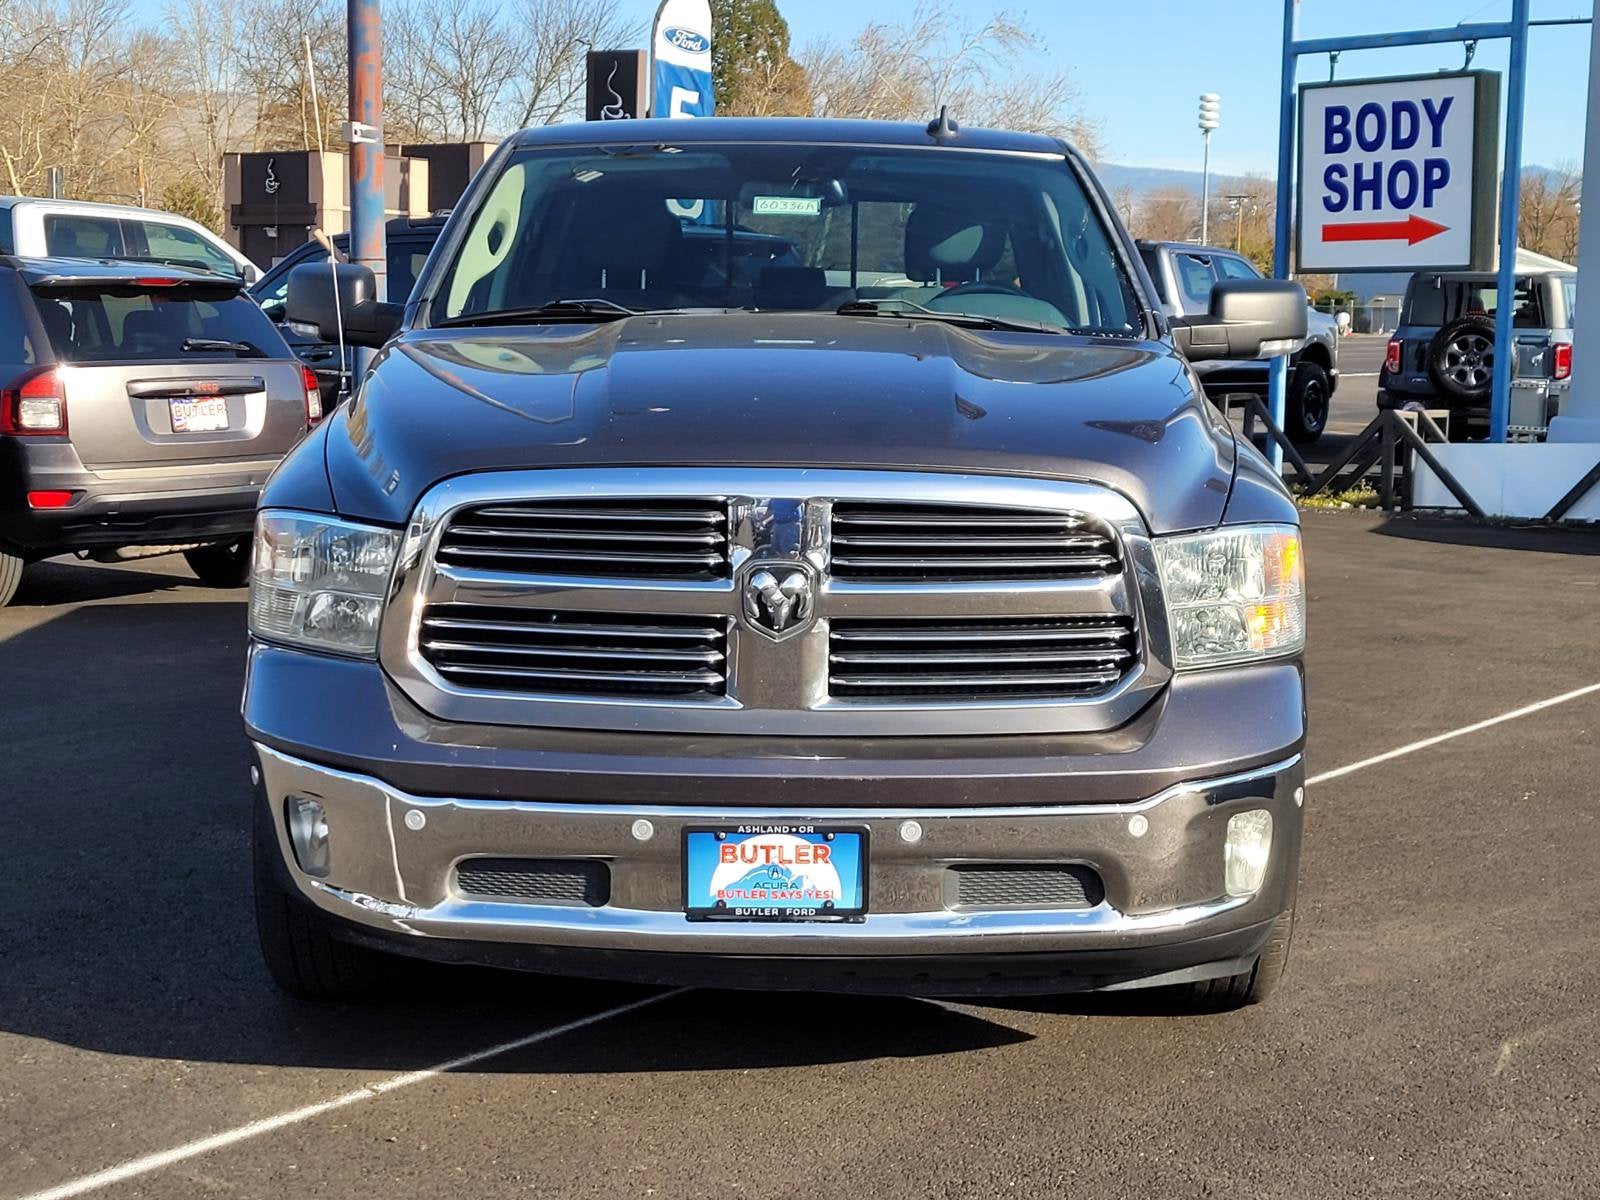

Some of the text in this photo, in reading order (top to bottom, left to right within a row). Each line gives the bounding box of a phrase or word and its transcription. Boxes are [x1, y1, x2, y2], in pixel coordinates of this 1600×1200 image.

[671, 29, 703, 51] Ford
[1324, 96, 1455, 154] BODY
[1322, 158, 1451, 213] SHOP
[174, 403, 225, 417] BUTLER
[737, 825, 814, 834] ASHLAND OR
[720, 844, 831, 864] BUTLER
[753, 881, 799, 890] ACURA
[717, 889, 834, 899] BUTLER SAYS YES!
[735, 907, 816, 916] BUTLER FORD
